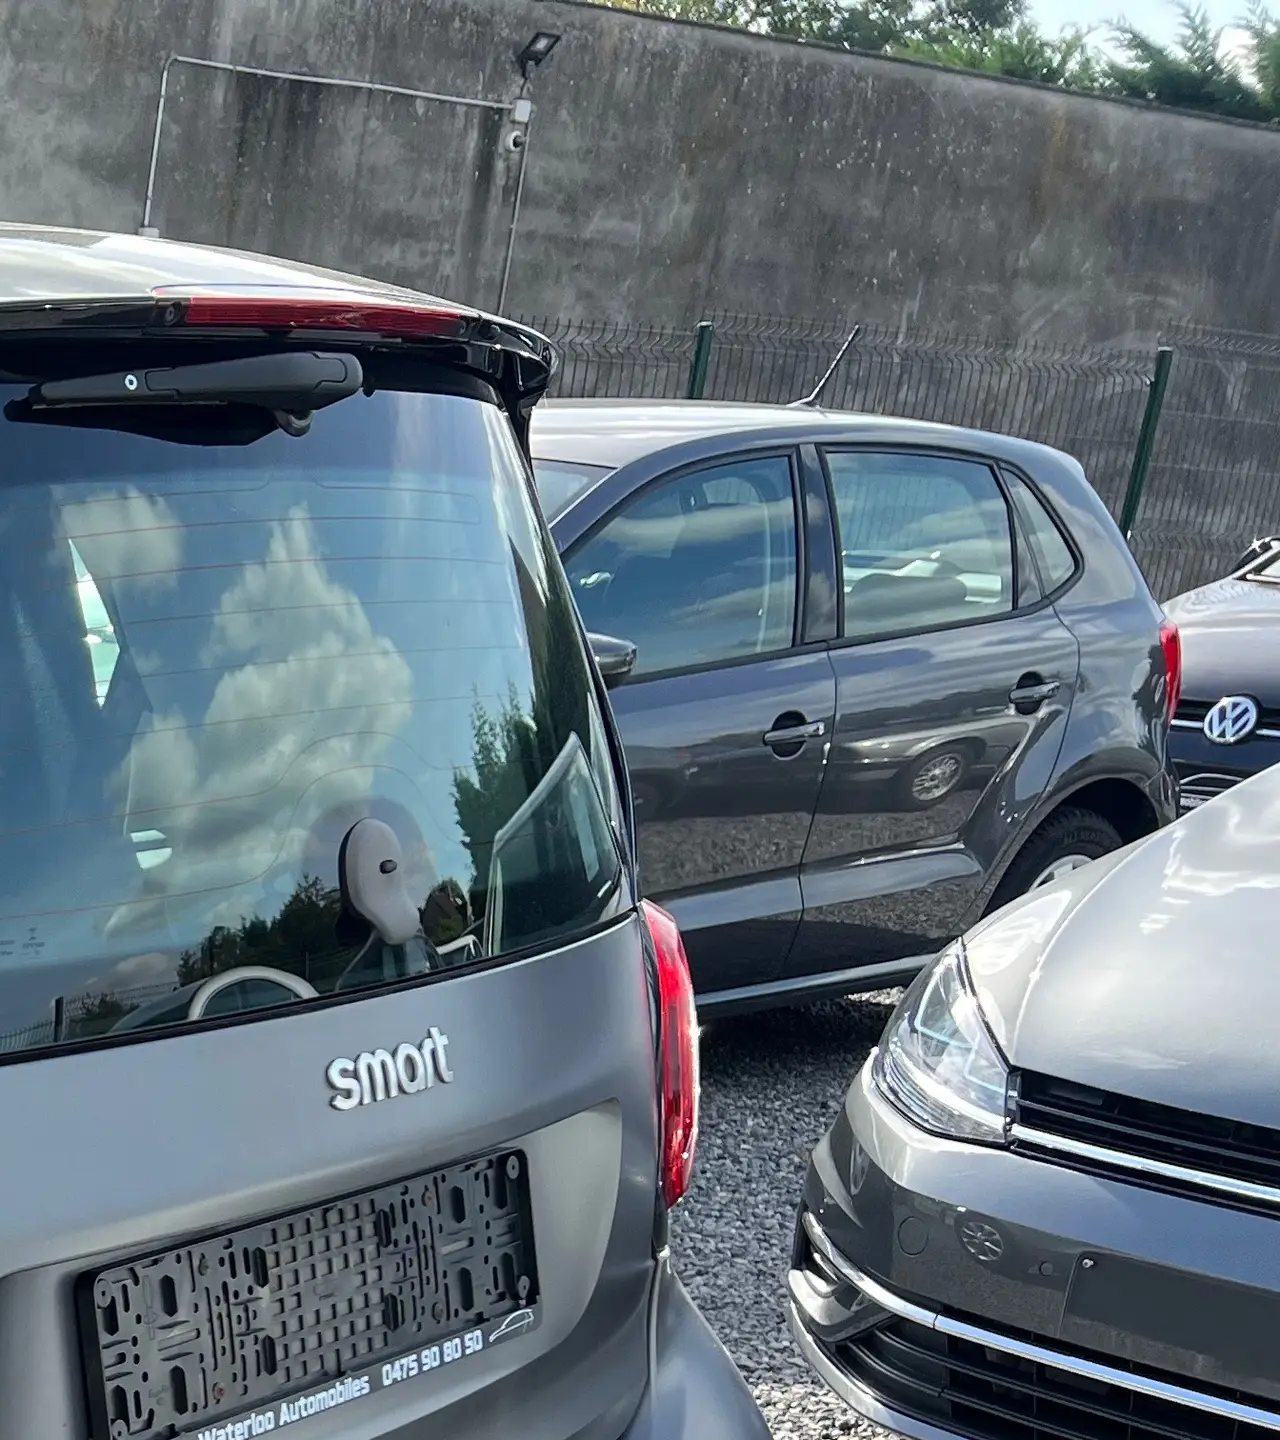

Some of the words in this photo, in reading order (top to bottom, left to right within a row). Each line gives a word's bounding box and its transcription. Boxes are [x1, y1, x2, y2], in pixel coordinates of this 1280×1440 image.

[326, 1025, 454, 1111] smart
[278, 1373, 370, 1427] Automobiles
[381, 1355, 419, 1386] 0475
[421, 1345, 440, 1372] 90
[443, 1337, 462, 1364] 80
[465, 1329, 483, 1354] 50
